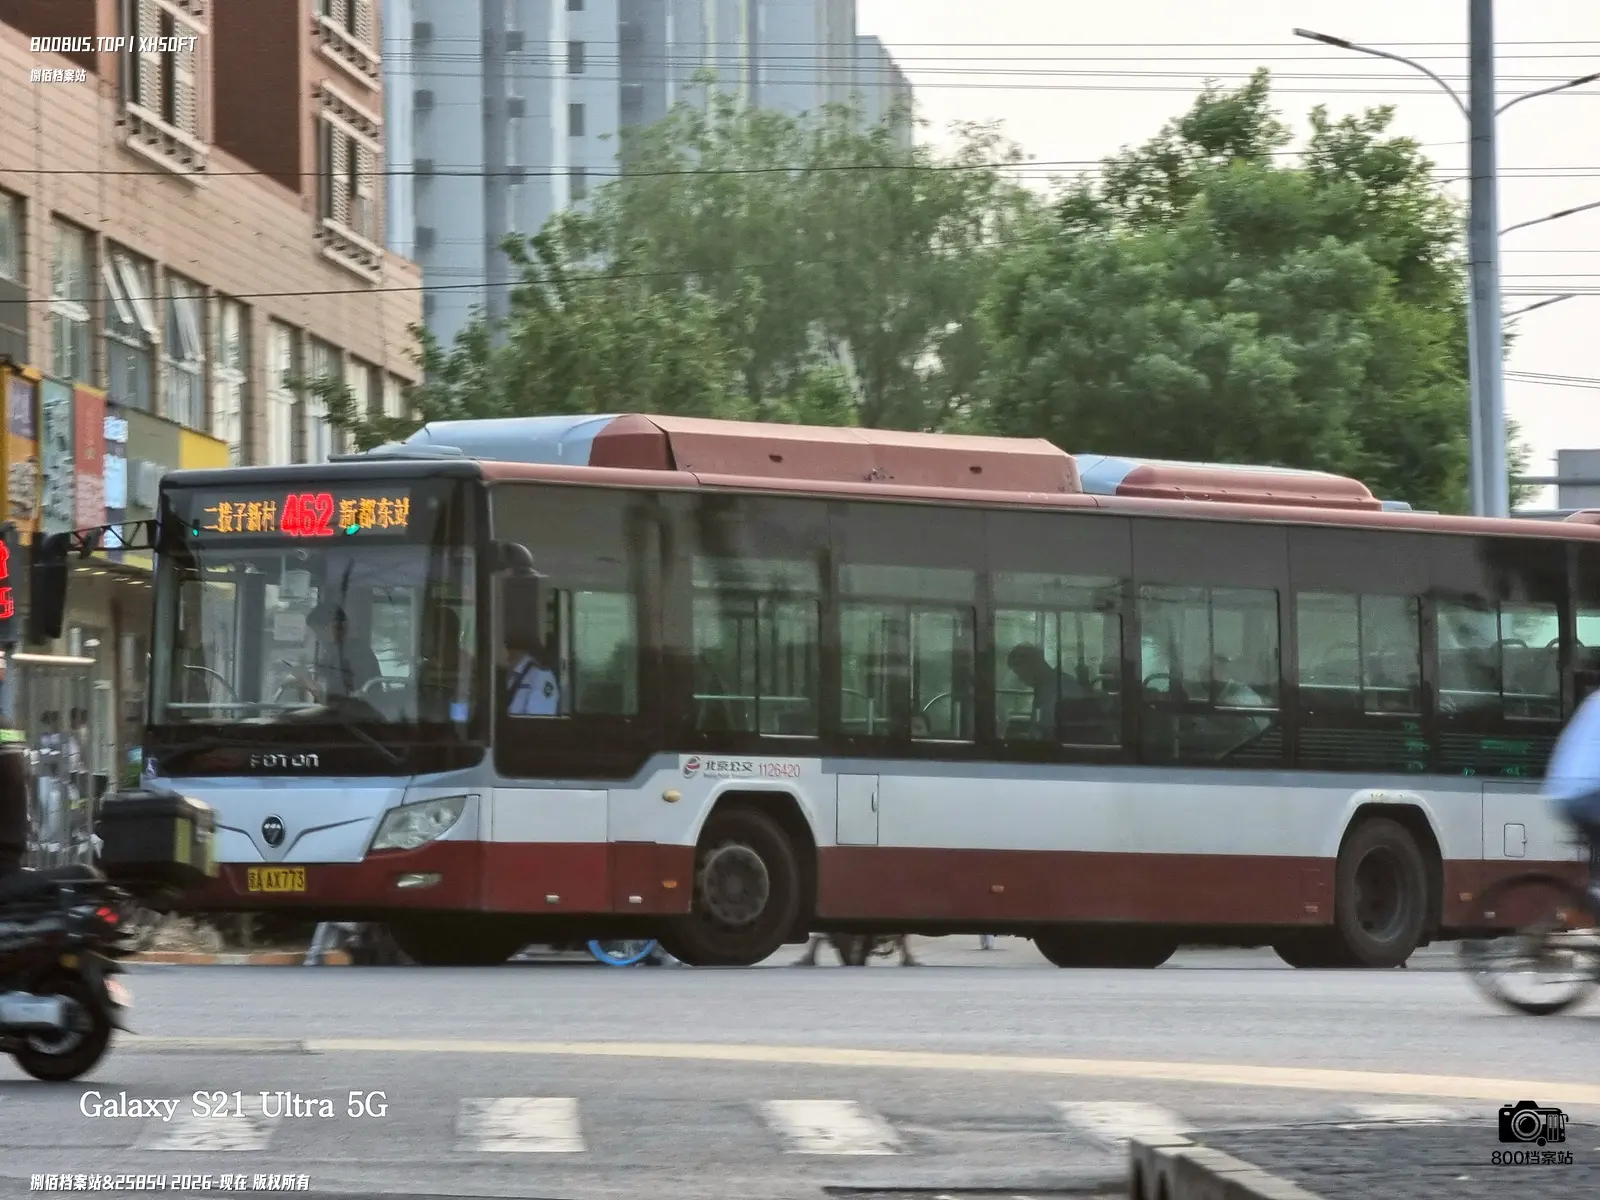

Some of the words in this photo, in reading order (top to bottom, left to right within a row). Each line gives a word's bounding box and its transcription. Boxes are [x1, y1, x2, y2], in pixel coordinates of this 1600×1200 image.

[281, 493, 335, 536] 462
[250, 753, 319, 768] FOTON
[704, 760, 753, 772] 北京公交
[759, 763, 800, 778] 1126420
